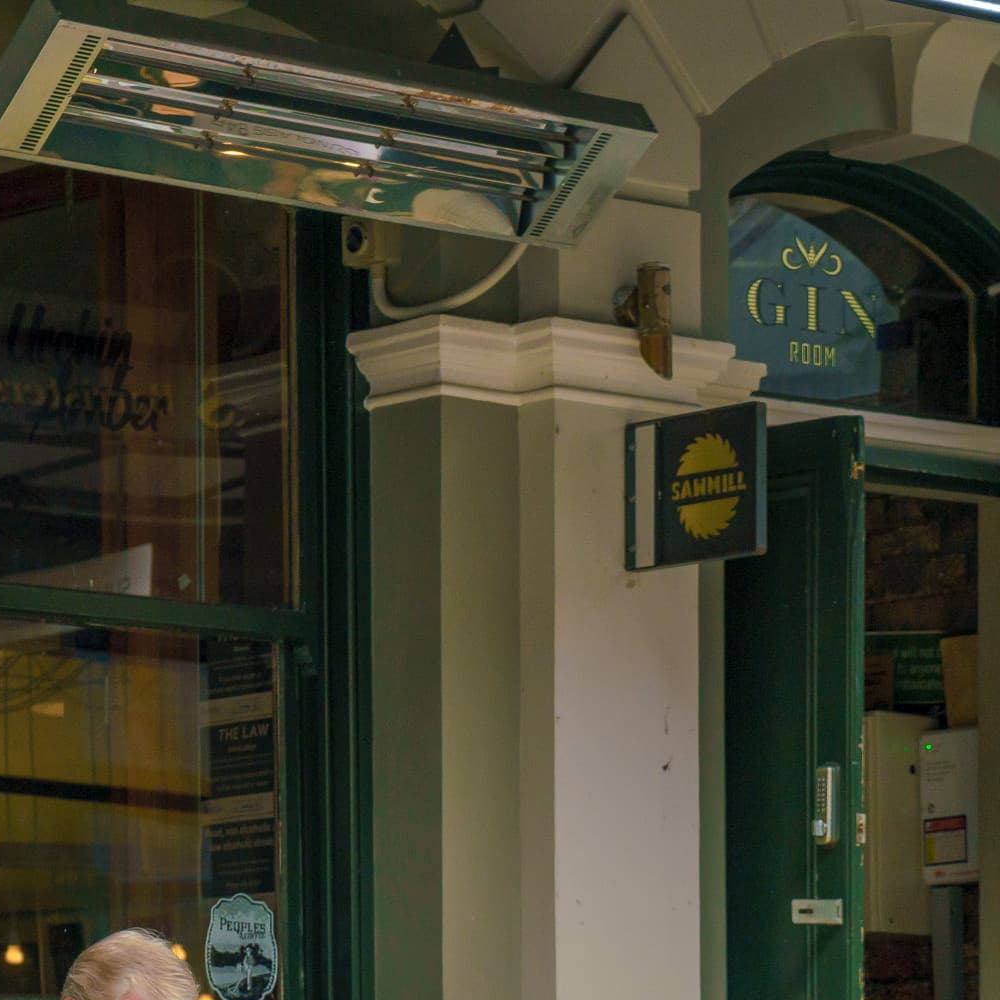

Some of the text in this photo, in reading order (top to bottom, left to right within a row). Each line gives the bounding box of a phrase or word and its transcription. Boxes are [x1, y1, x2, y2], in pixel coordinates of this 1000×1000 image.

[747, 277, 877, 338] GIN
[789, 341, 837, 367] ROOM
[671, 471, 748, 500] SAWMILL
[218, 722, 270, 742] THE LAW
